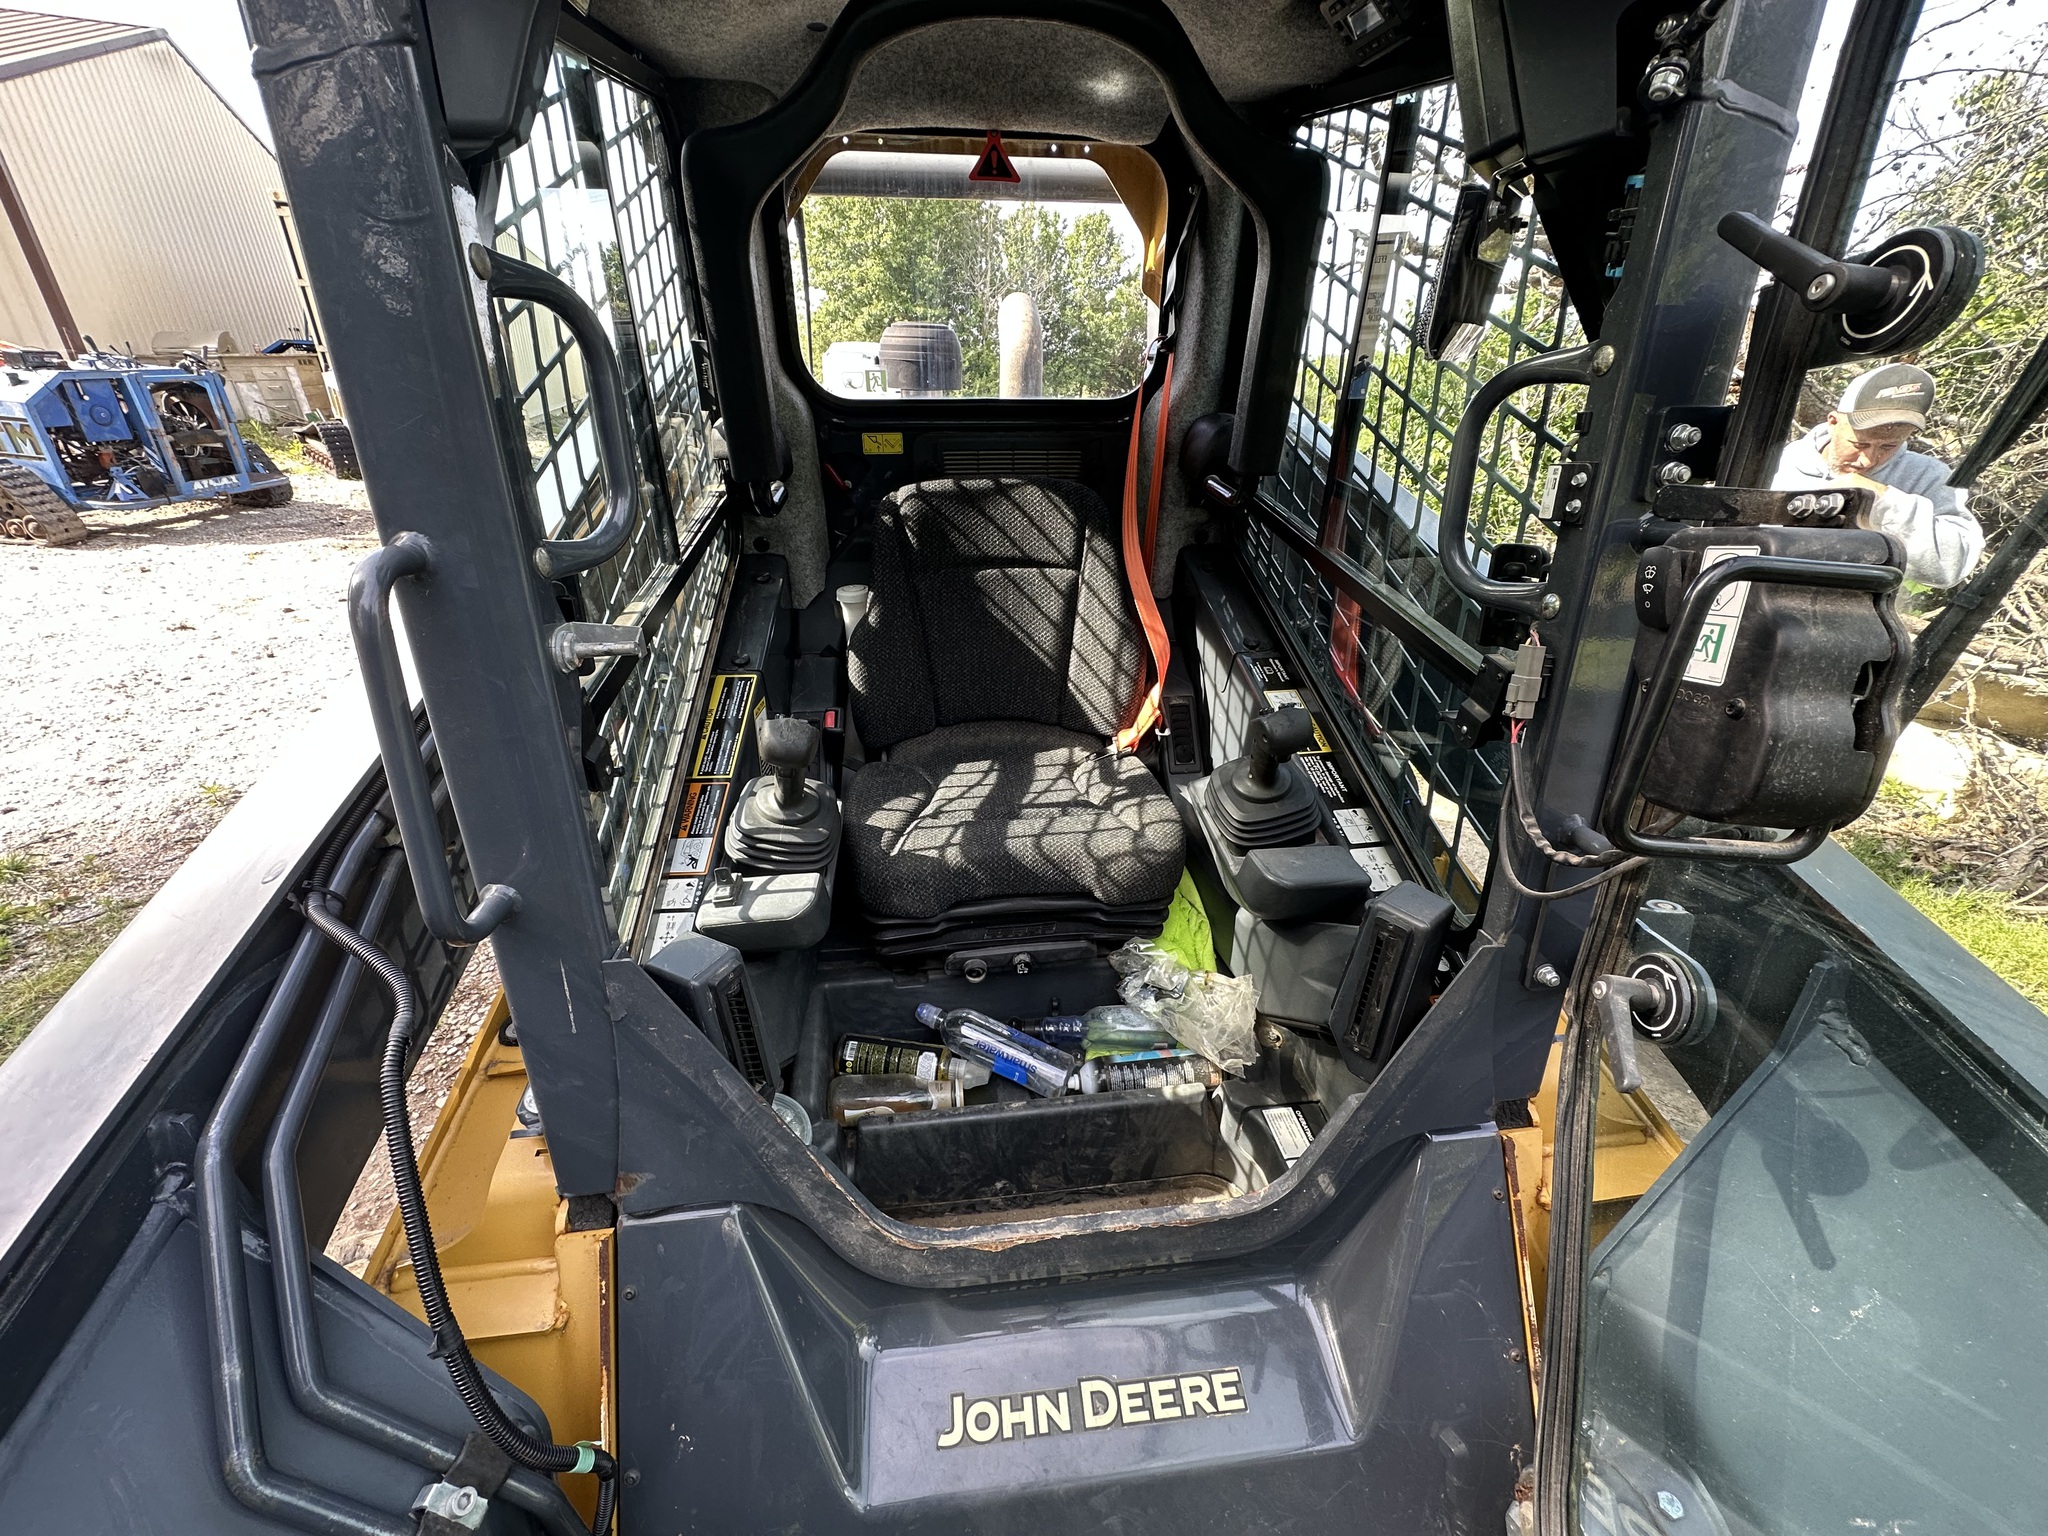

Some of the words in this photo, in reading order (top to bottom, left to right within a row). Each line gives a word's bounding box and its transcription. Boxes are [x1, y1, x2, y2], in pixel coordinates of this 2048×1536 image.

[1326, 761, 1348, 793] IMPORTANT
[681, 791, 698, 825] WARNING
[973, 1039, 1038, 1073] smartwater
[937, 1391, 1073, 1448] JOHN
[1080, 1371, 1246, 1430] DEERE
